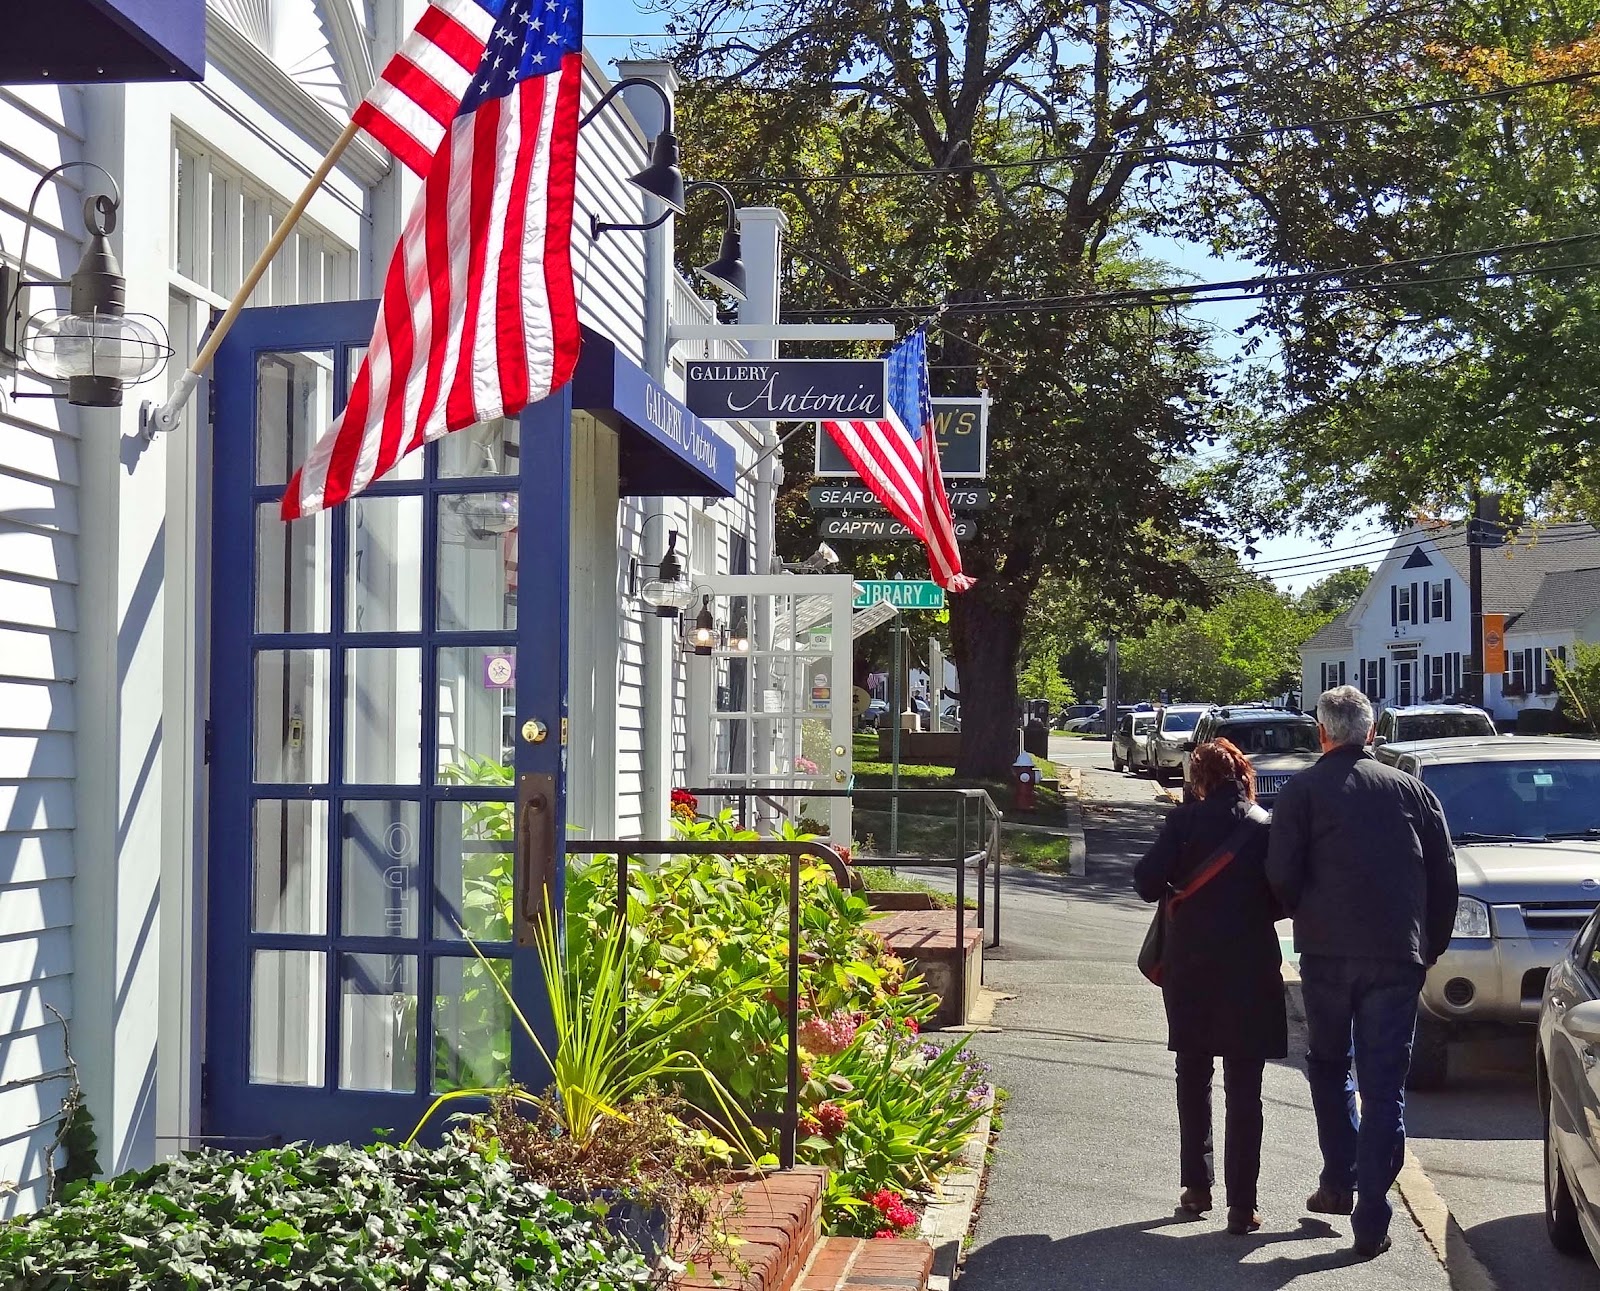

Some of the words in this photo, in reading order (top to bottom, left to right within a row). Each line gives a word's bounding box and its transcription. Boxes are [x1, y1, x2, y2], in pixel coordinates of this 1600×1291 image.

[690, 366, 770, 381] GALLERY
[727, 371, 881, 414] Antonia
[646, 383, 683, 445] GALLERY
[683, 413, 718, 474] Antonia
[828, 521, 885, 535] CAPT'N
[929, 593, 940, 605] LN
